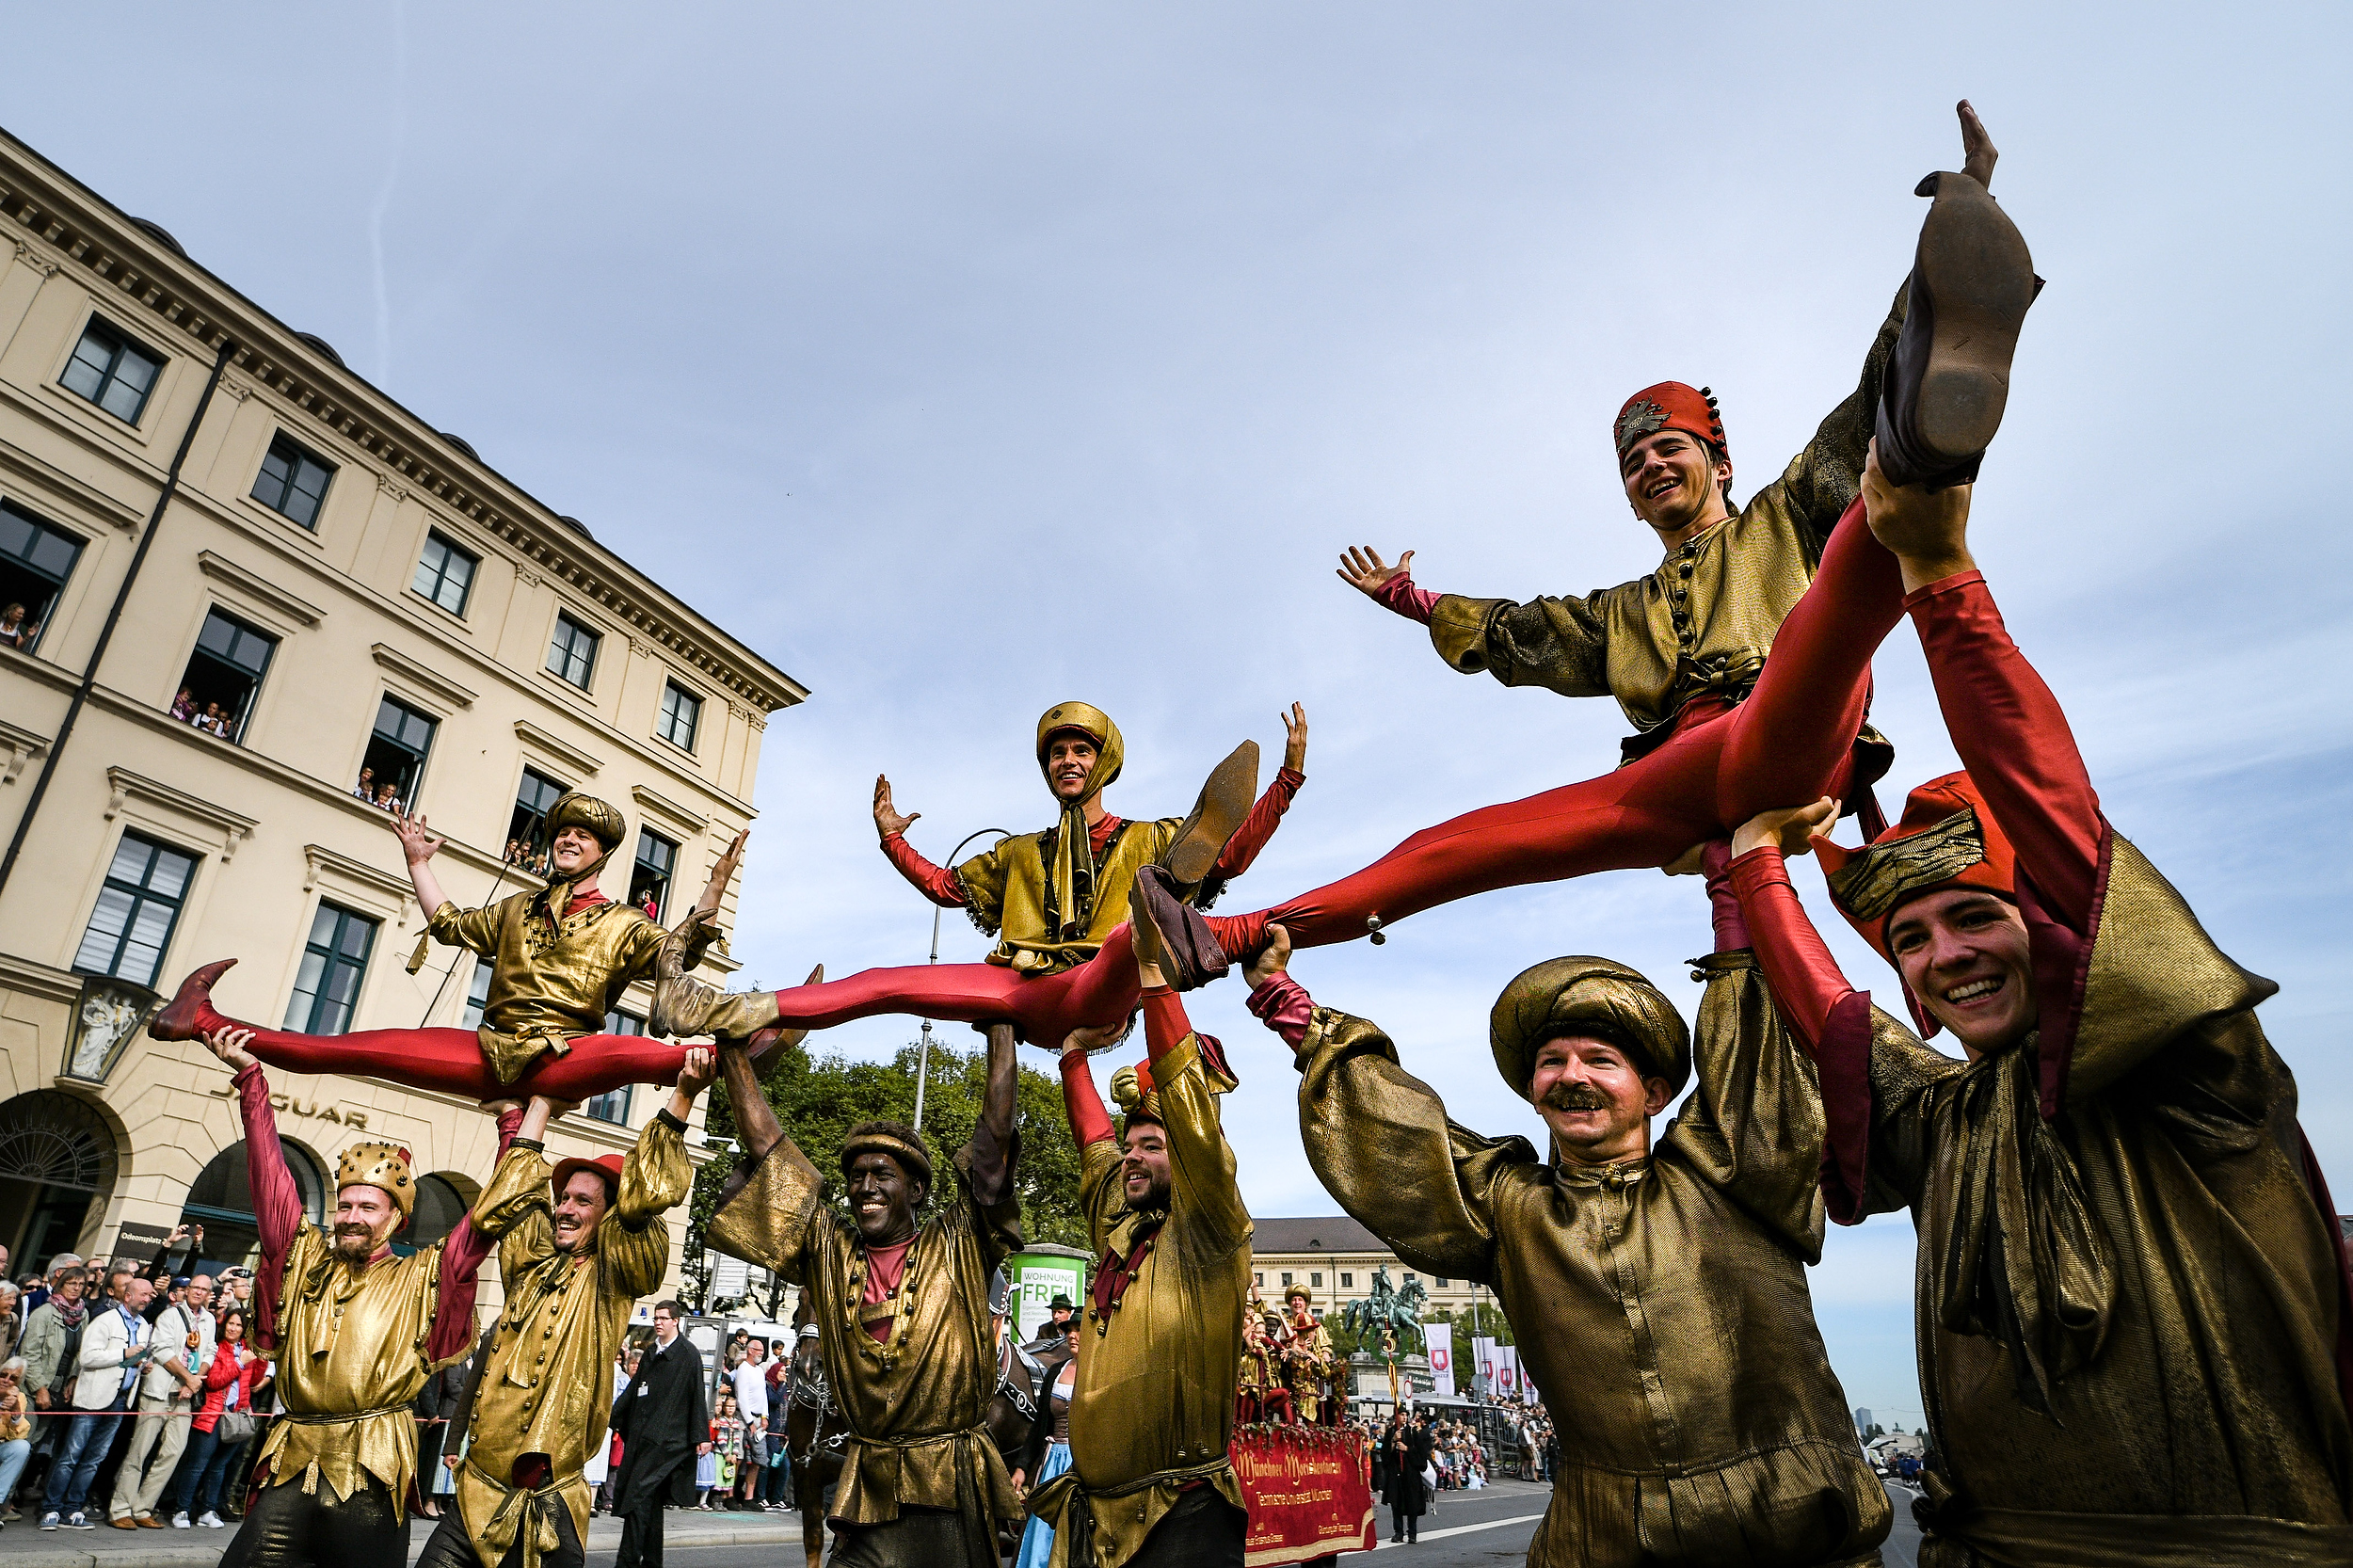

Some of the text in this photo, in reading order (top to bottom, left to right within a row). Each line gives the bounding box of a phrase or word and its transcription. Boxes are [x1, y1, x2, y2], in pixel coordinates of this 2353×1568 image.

[210, 1084, 369, 1129] JGUAR
[120, 1232, 162, 1244] Odeonsplatz
[1024, 1272, 1073, 1283] WOHNUNG
[1382, 1329, 1396, 1352] 3
